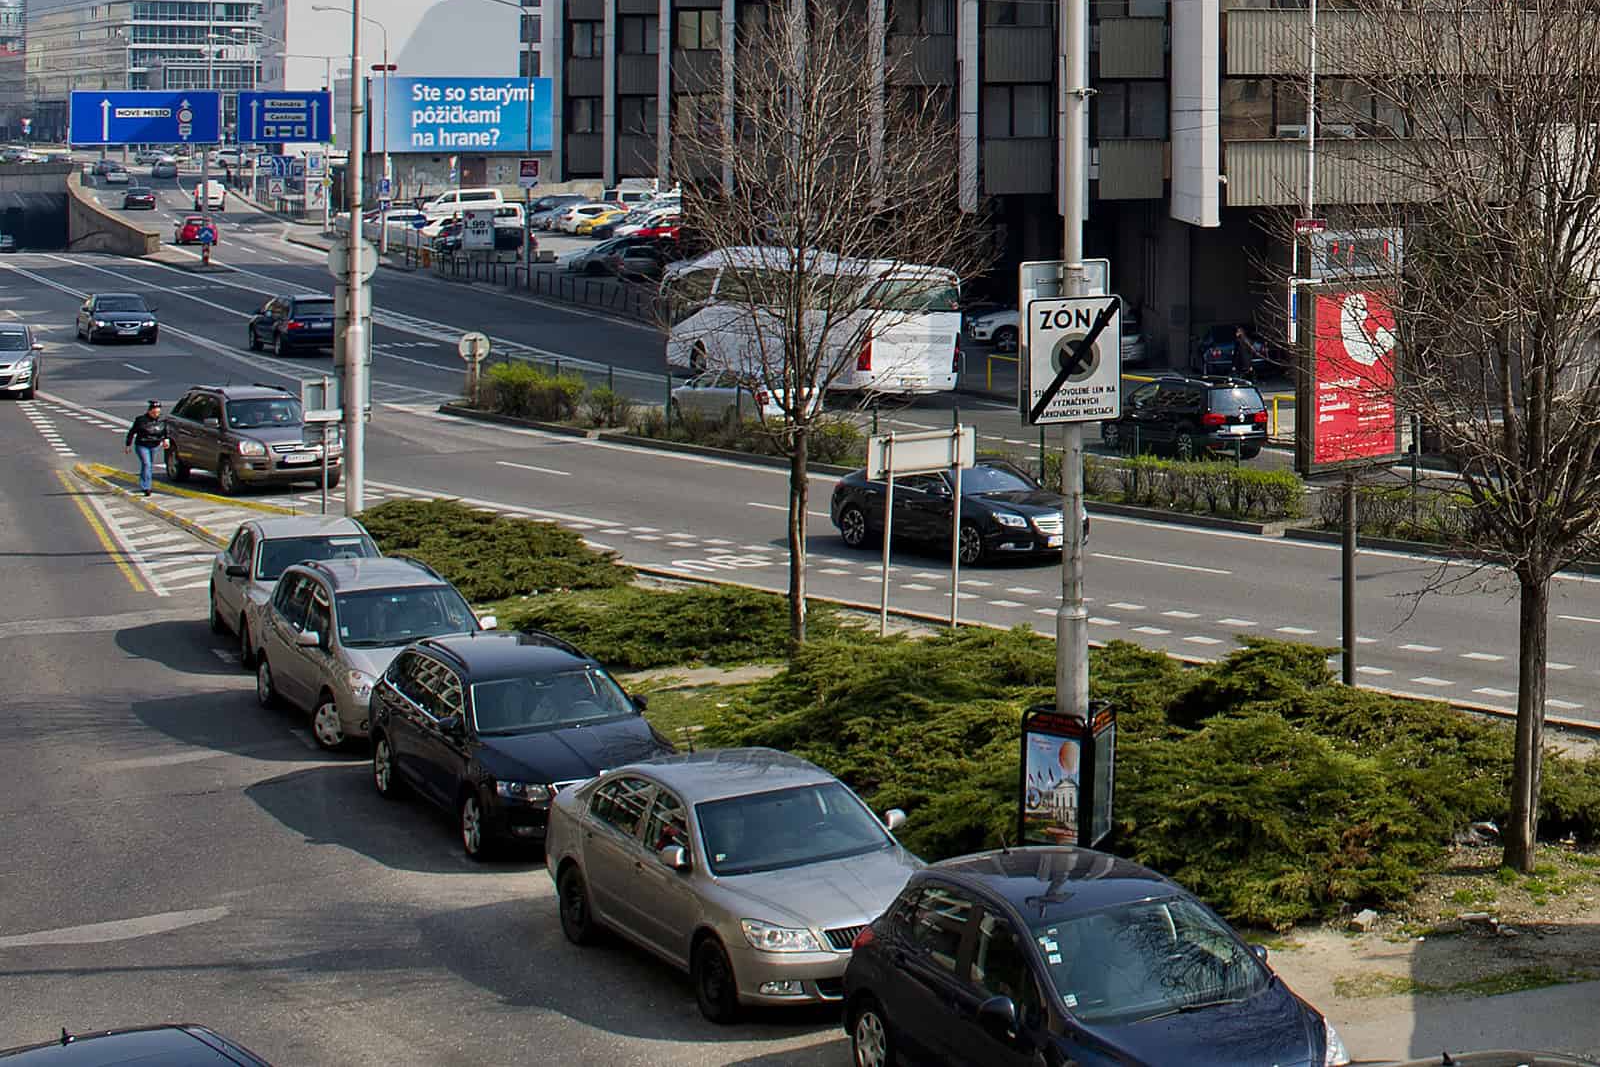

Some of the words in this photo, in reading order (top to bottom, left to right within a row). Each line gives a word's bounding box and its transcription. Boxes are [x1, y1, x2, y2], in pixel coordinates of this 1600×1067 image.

[412, 83, 441, 101] Ste
[445, 87, 466, 101] so
[469, 82, 535, 106] starými
[412, 105, 501, 127] pôžičkami
[412, 131, 434, 146] na
[439, 127, 500, 146] hrane?
